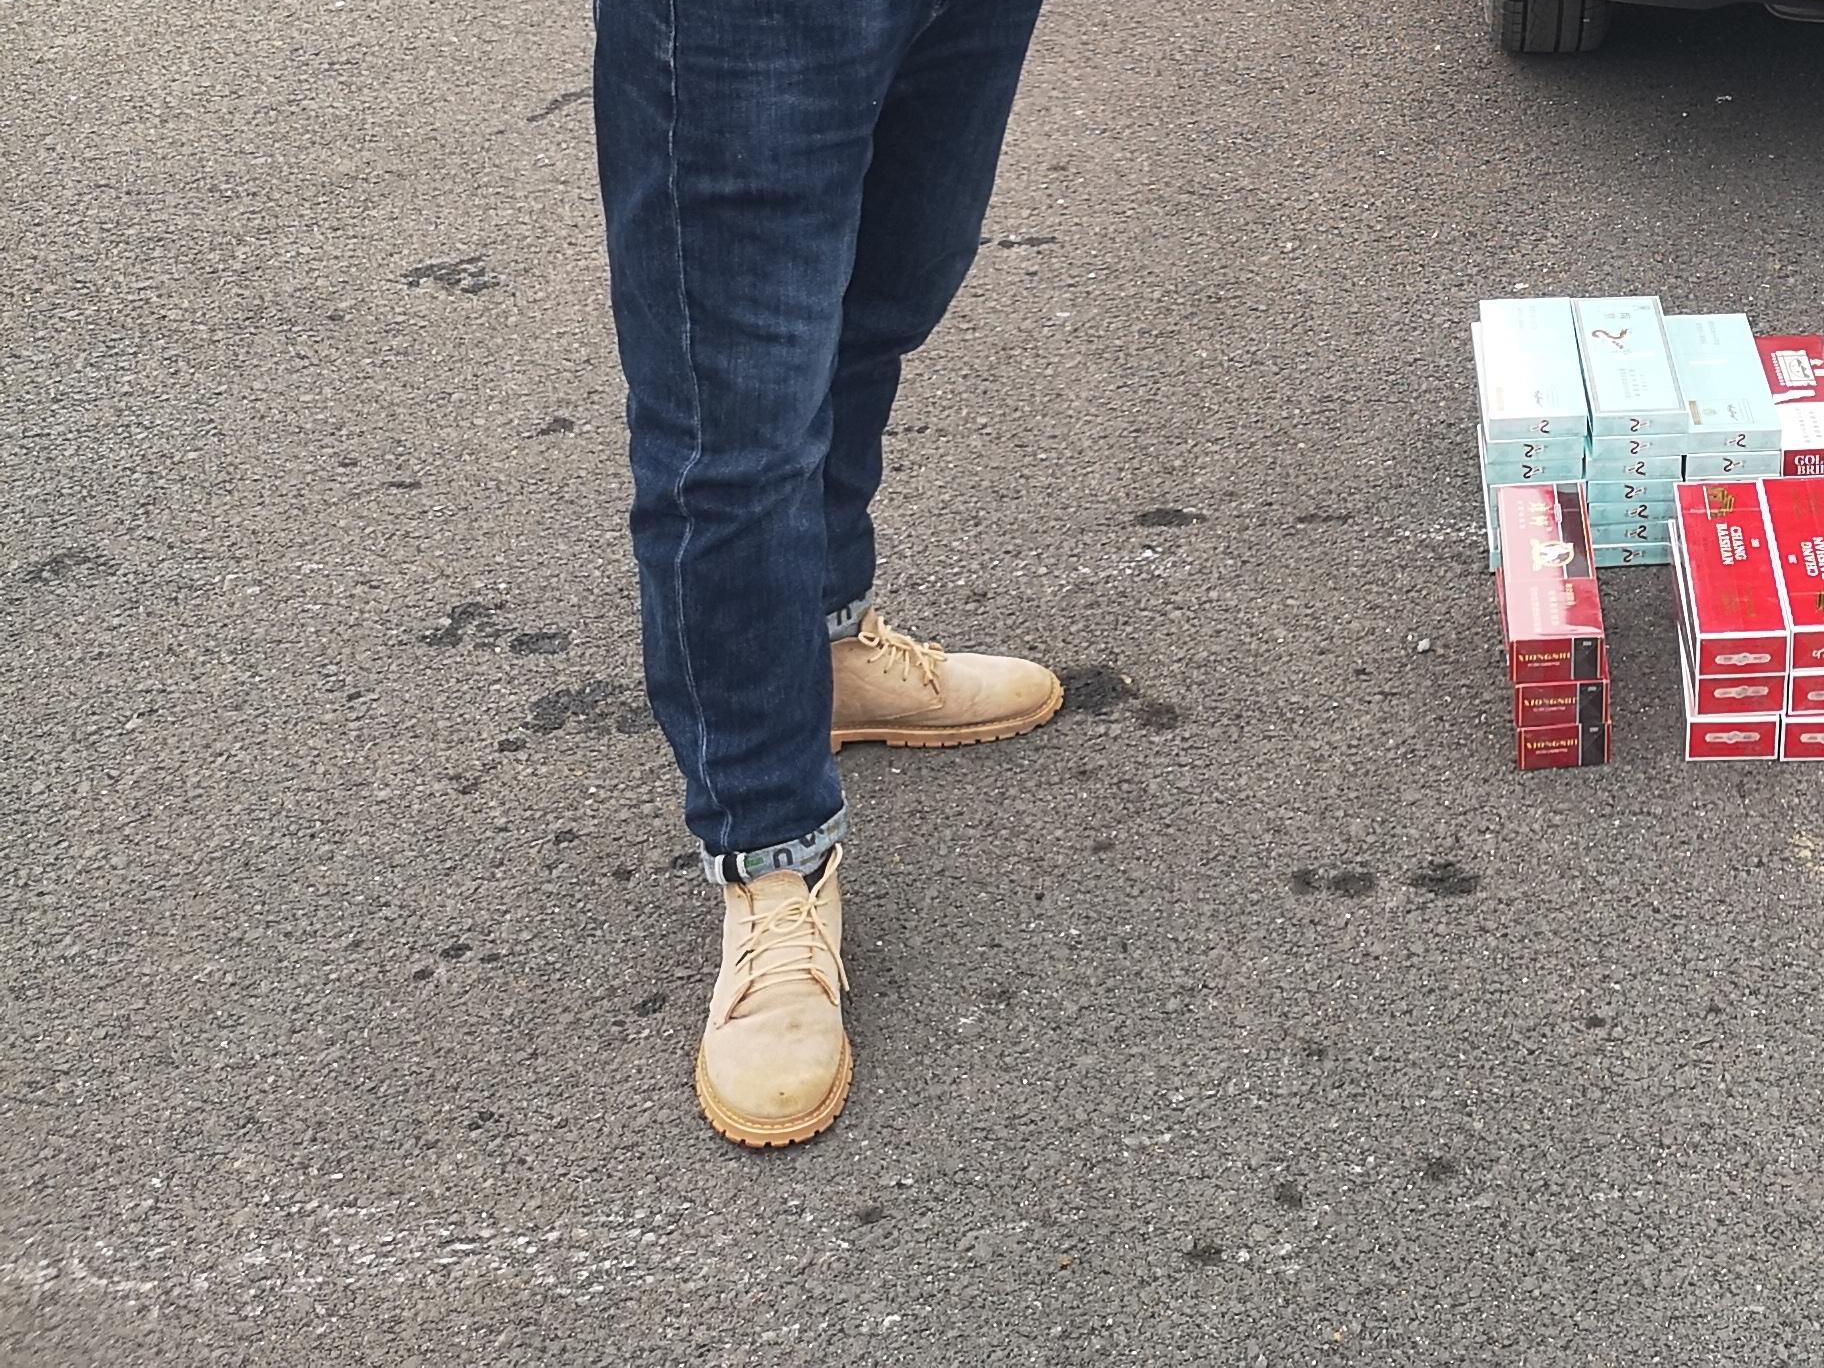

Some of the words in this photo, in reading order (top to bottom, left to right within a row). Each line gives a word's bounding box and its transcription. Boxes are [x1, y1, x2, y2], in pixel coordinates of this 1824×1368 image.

[1716, 524, 1734, 565] BAISHAN
[1730, 526, 1747, 560] CHANG
[1801, 542, 1818, 576] CHANG
